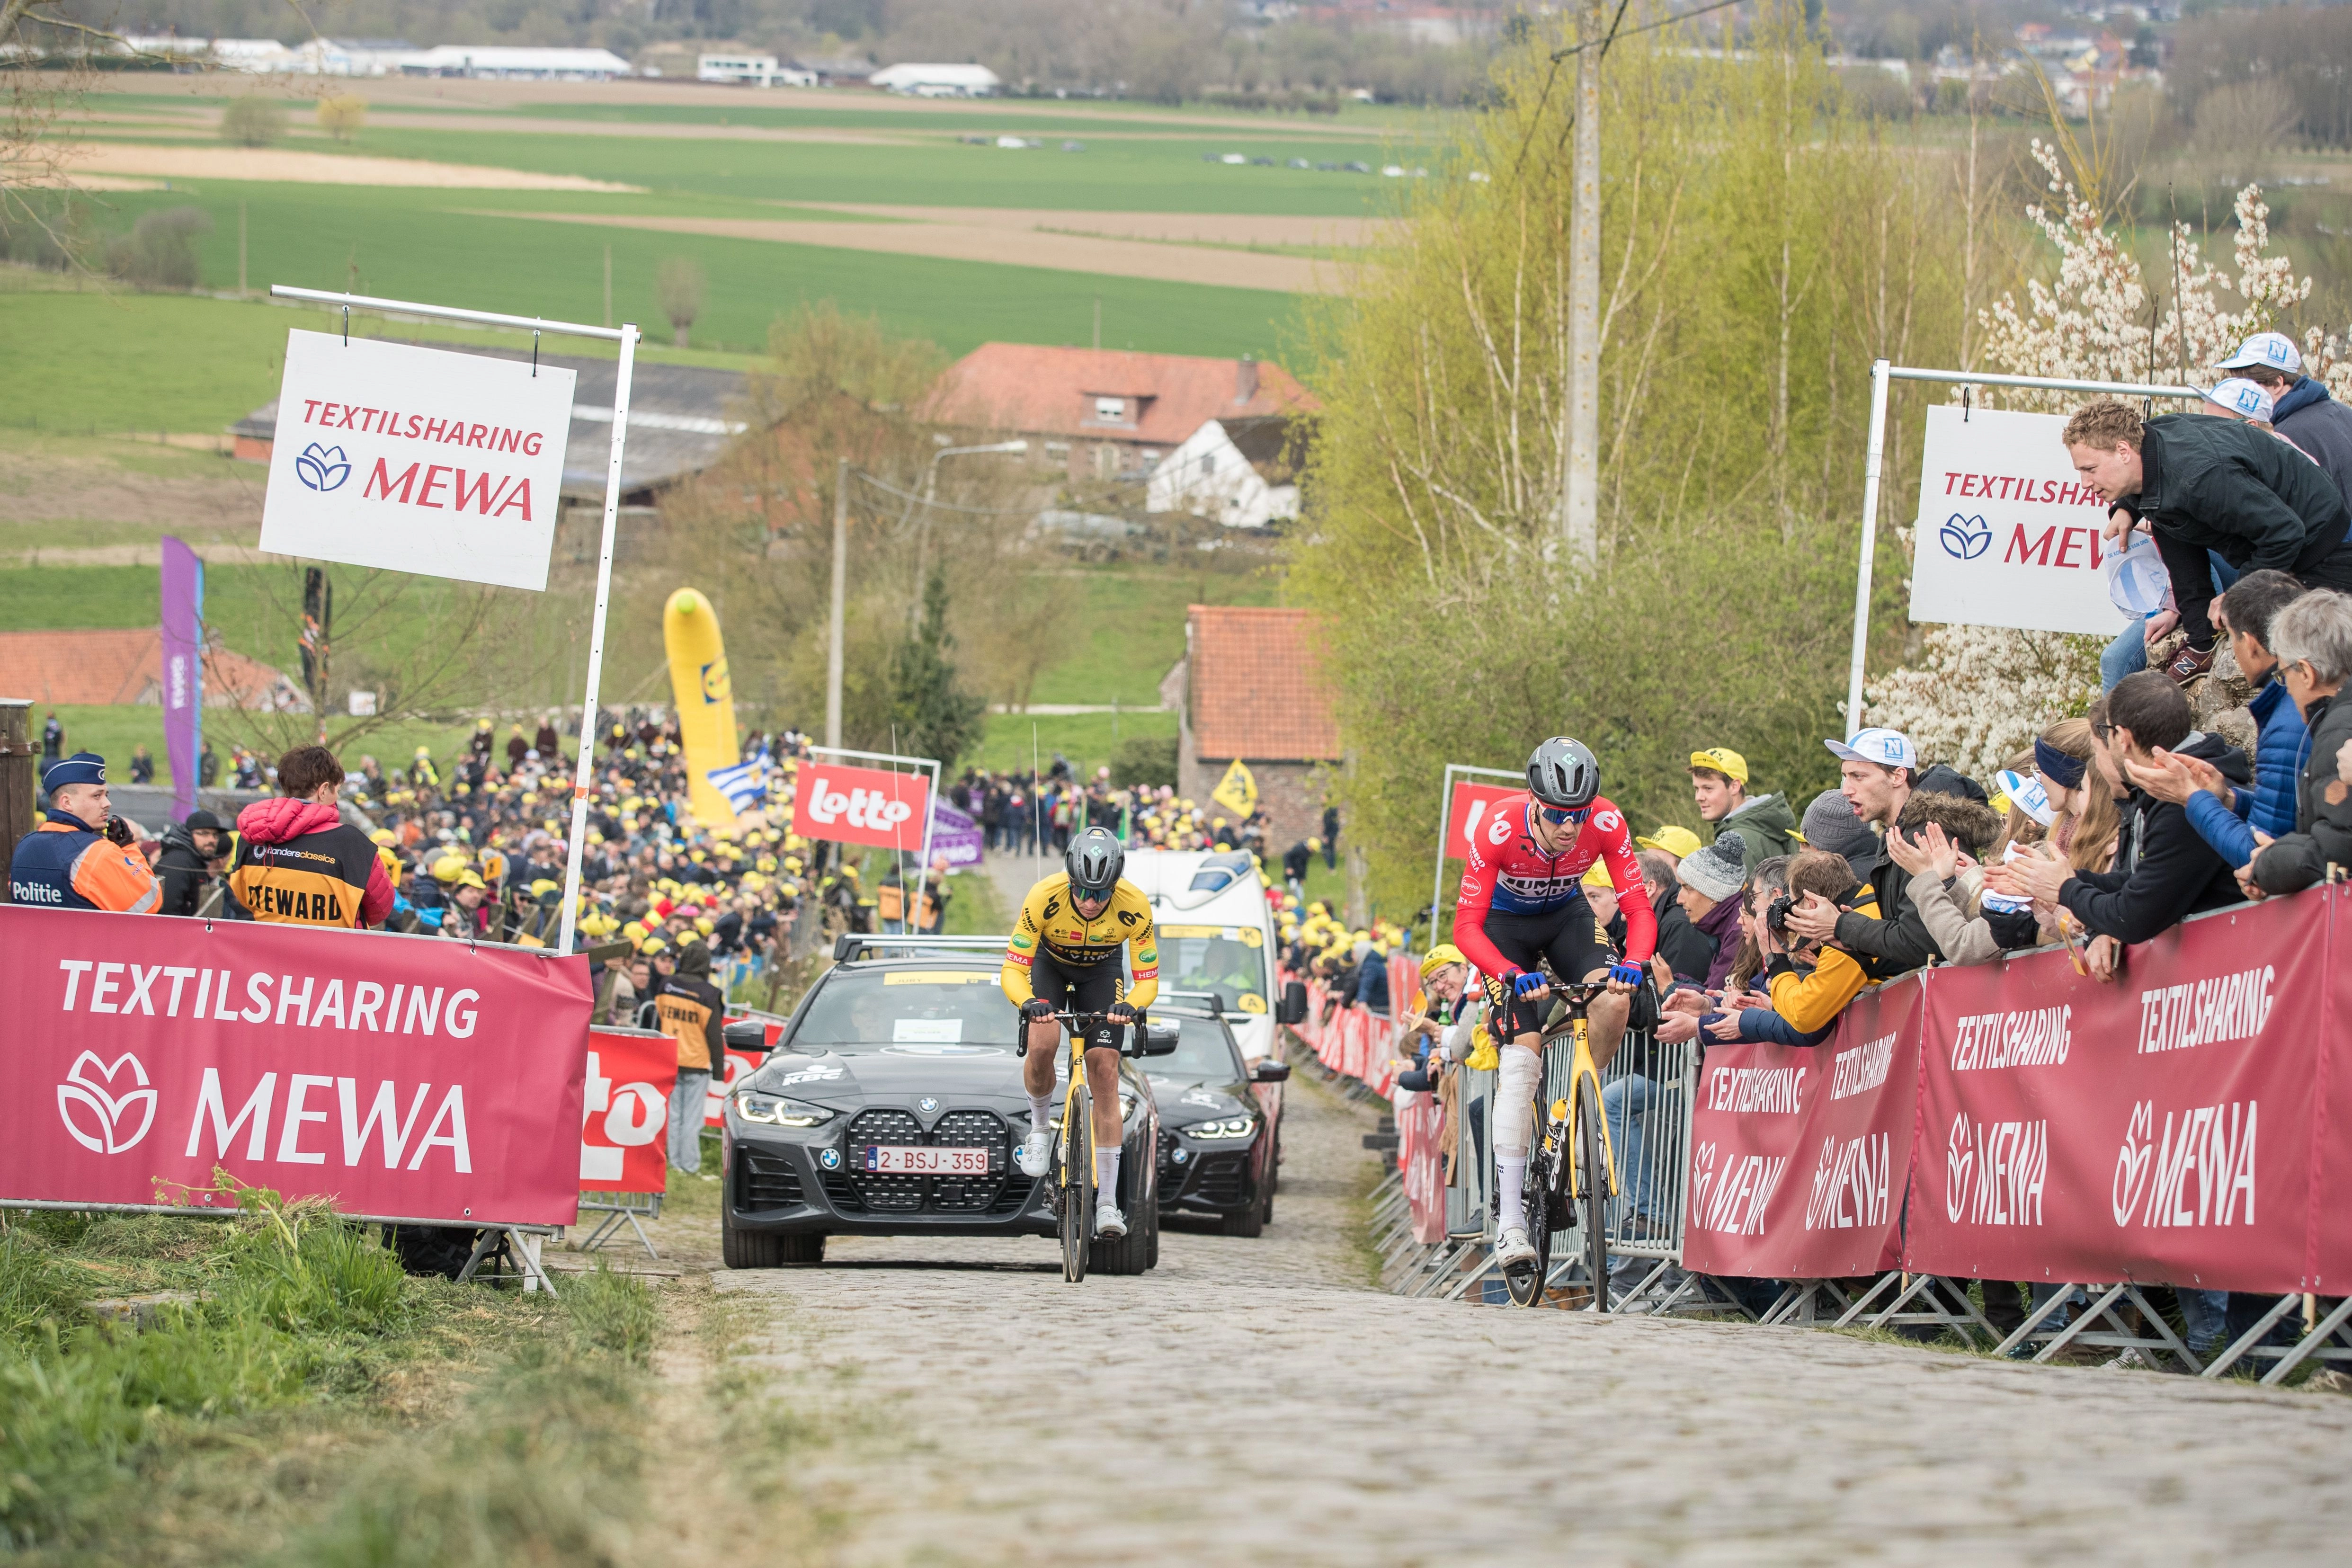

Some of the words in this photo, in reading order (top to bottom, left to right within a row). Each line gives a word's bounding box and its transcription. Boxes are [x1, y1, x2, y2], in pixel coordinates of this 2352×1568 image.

[304, 399, 544, 456] TEXTILSHARING
[363, 457, 532, 522] MEWA
[1565, 844, 1577, 857] VISMA
[13, 881, 62, 902] Politie
[1461, 879, 1479, 891] Campina
[1506, 876, 1580, 890] JUMB
[1022, 918, 1032, 933] VISM
[1025, 907, 1038, 934] JUMBO
[1070, 915, 1085, 927] JUMBO
[1006, 952, 1028, 965] HEMA
[59, 959, 481, 1040] TEXTILSHARING
[2138, 964, 2275, 1054] TEXTILSHARING
[1951, 1004, 2072, 1071] TEXTILSHARING
[782, 1072, 841, 1086] KBC
[1830, 1031, 1897, 1101] TEXTILSHARING
[1708, 1067, 1807, 1114] TEXTILSHARING
[185, 1067, 472, 1174] MEWA
[868, 1159, 876, 1168] B
[881, 1151, 985, 1170] 2-BSJ-359
[1817, 1131, 1889, 1229] MEWA
[1971, 1119, 2048, 1226] MEWA
[2142, 1100, 2257, 1228] MEWA
